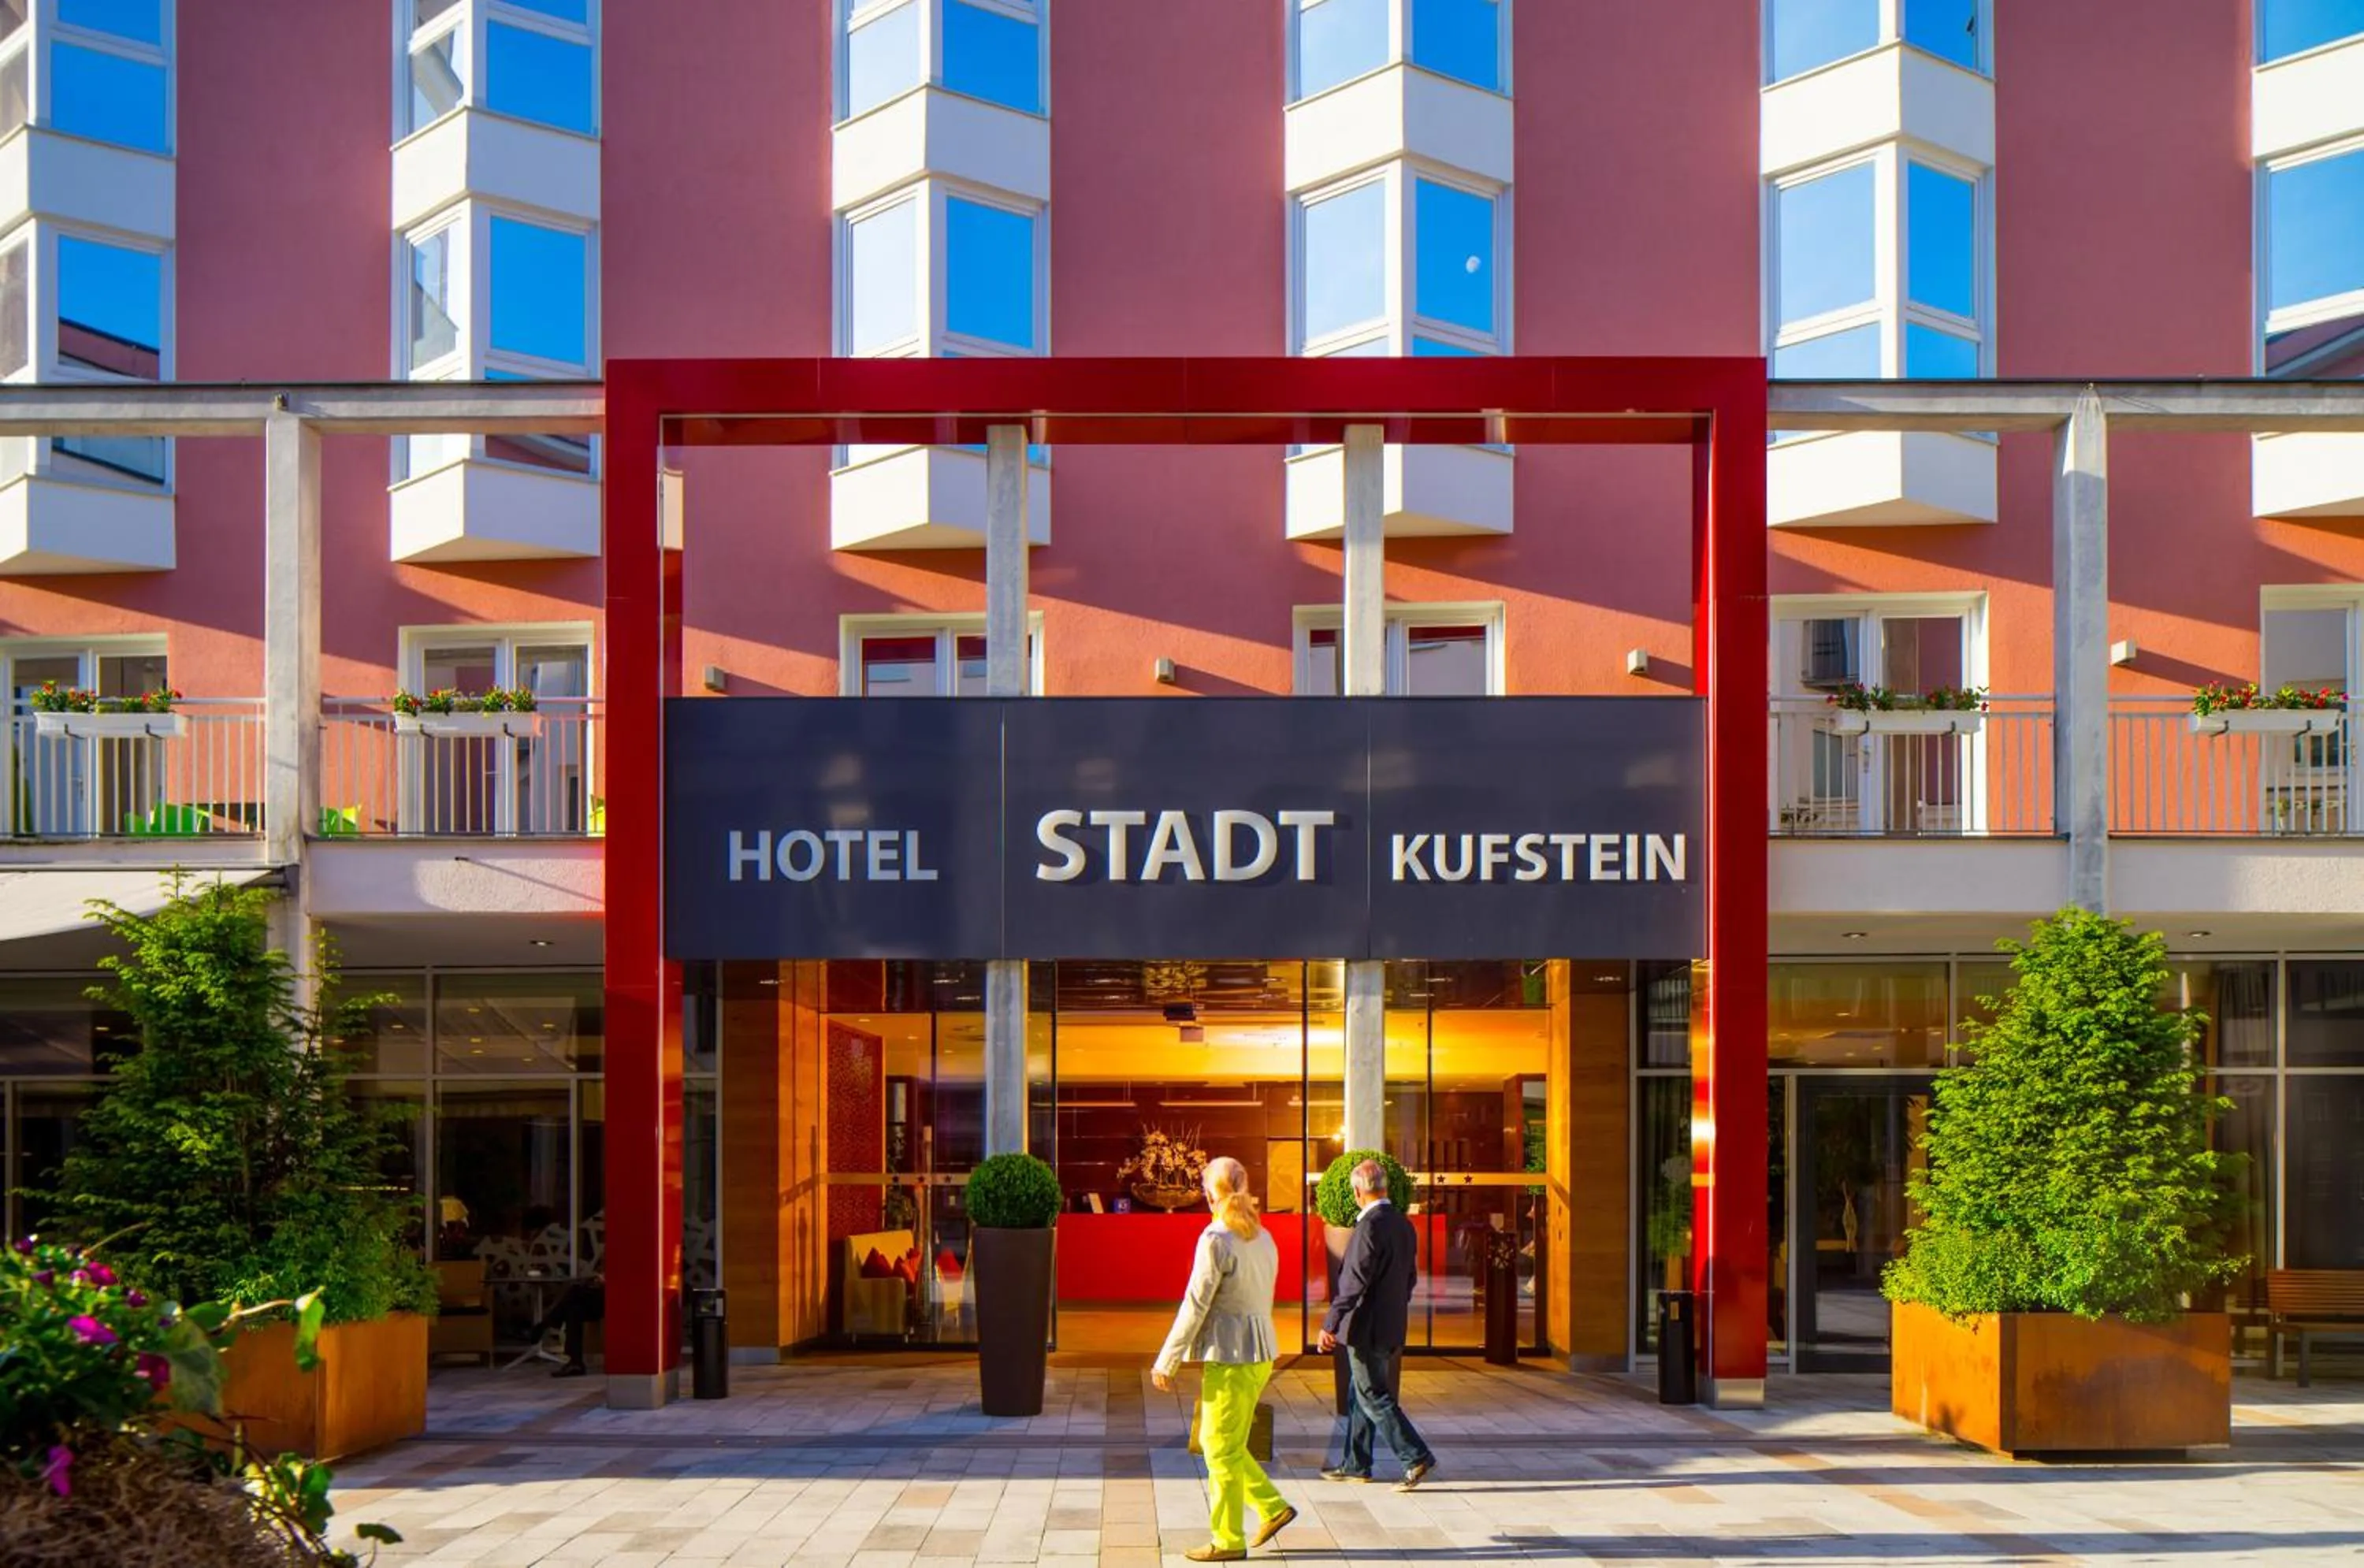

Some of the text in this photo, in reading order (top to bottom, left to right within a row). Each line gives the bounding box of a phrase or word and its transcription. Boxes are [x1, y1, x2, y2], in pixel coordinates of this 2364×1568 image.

[728, 808, 1686, 882] HOTEL STADT KUFSTEIN
